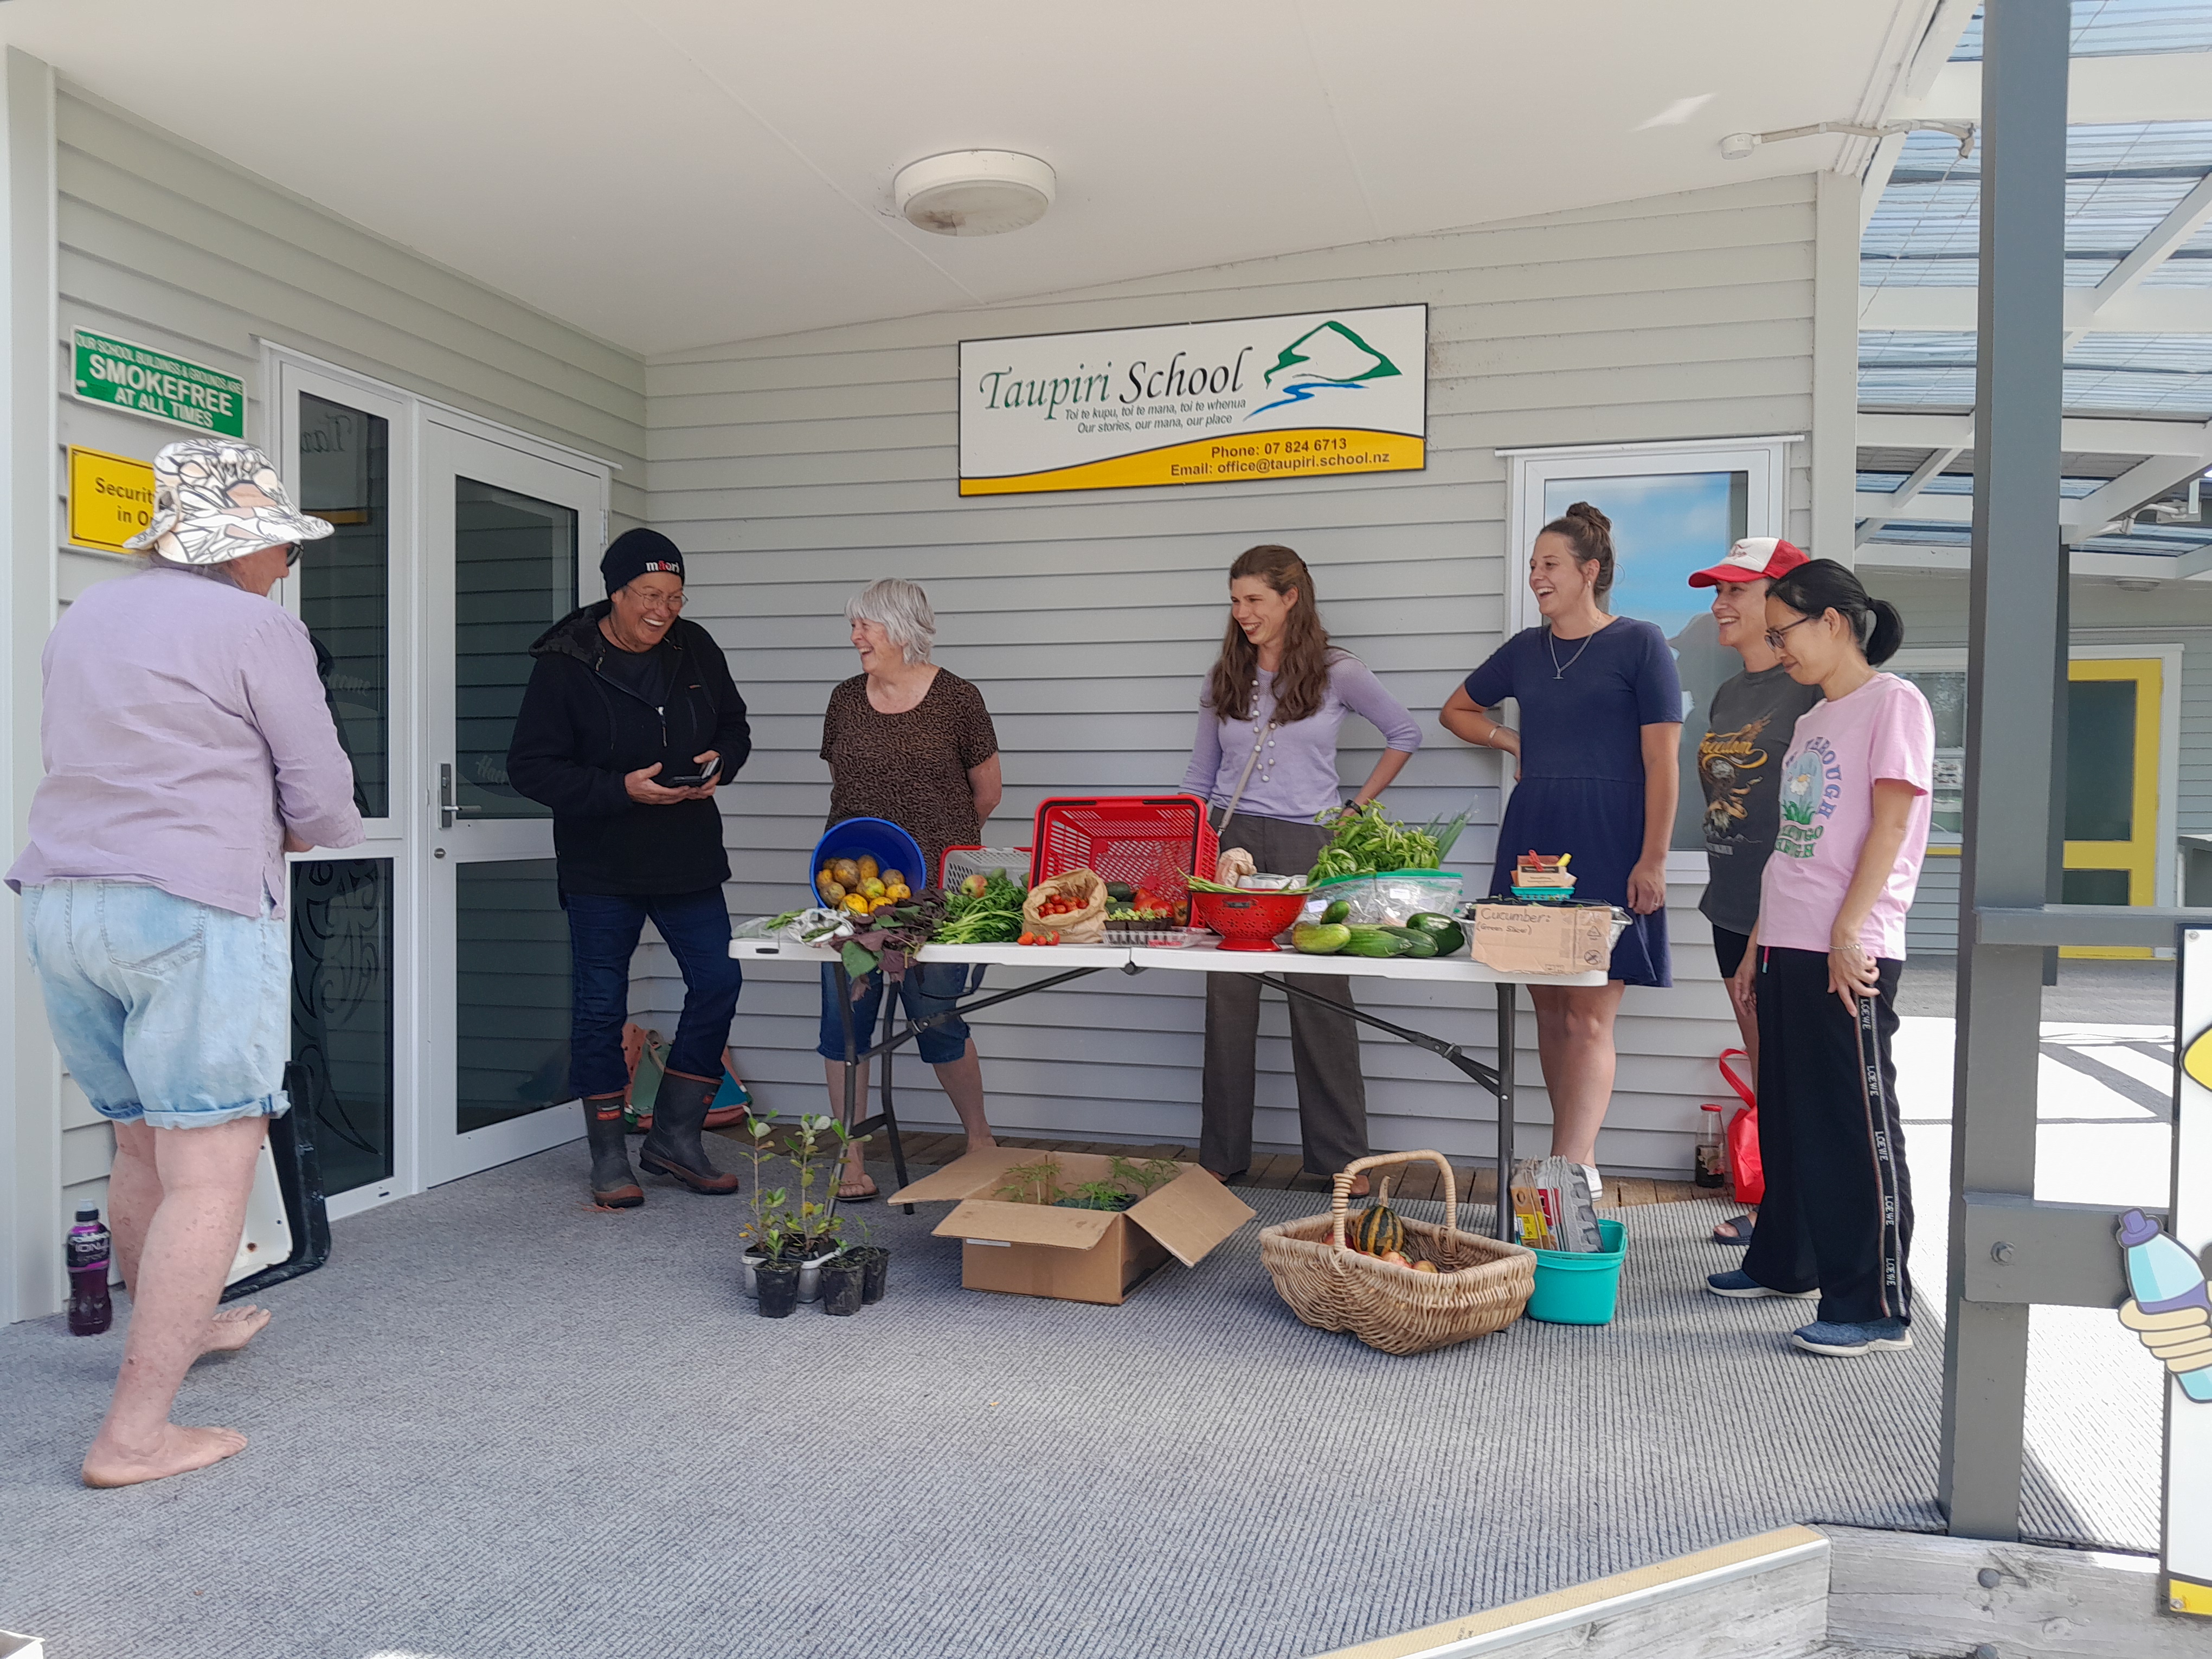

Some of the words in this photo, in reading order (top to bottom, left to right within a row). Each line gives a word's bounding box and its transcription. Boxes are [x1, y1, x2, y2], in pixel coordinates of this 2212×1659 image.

[88, 353, 234, 417] SMOKEFREE
[979, 361, 1113, 420] Taupiri
[1119, 346, 1253, 404] School
[114, 387, 137, 406] AT
[138, 391, 169, 416] ALL
[169, 400, 214, 428] TIMES
[1065, 408, 1079, 420] Toi
[1081, 409, 1090, 419] te
[1092, 407, 1118, 421] kupu,
[1122, 405, 1134, 416] toi
[1136, 405, 1145, 416] te
[1148, 404, 1177, 415] mana,
[1180, 400, 1193, 413] toi
[1195, 400, 1204, 411] te
[1207, 398, 1246, 410] whenua
[1078, 422, 1096, 433] Our
[1098, 420, 1131, 433] stories,
[1135, 420, 1152, 430] our
[1154, 418, 1183, 429] mana,
[1186, 417, 1204, 426] our
[1205, 413, 1232, 428] place
[1212, 446, 1259, 459] Phone:
[1264, 442, 1280, 454] 07
[1285, 440, 1309, 453] 824
[1314, 438, 1347, 451] 6713
[1171, 462, 1213, 476] Email:
[1218, 452, 1390, 474] office@taupiri.school.nz
[94, 476, 155, 505] Securit
[117, 504, 132, 524] in
